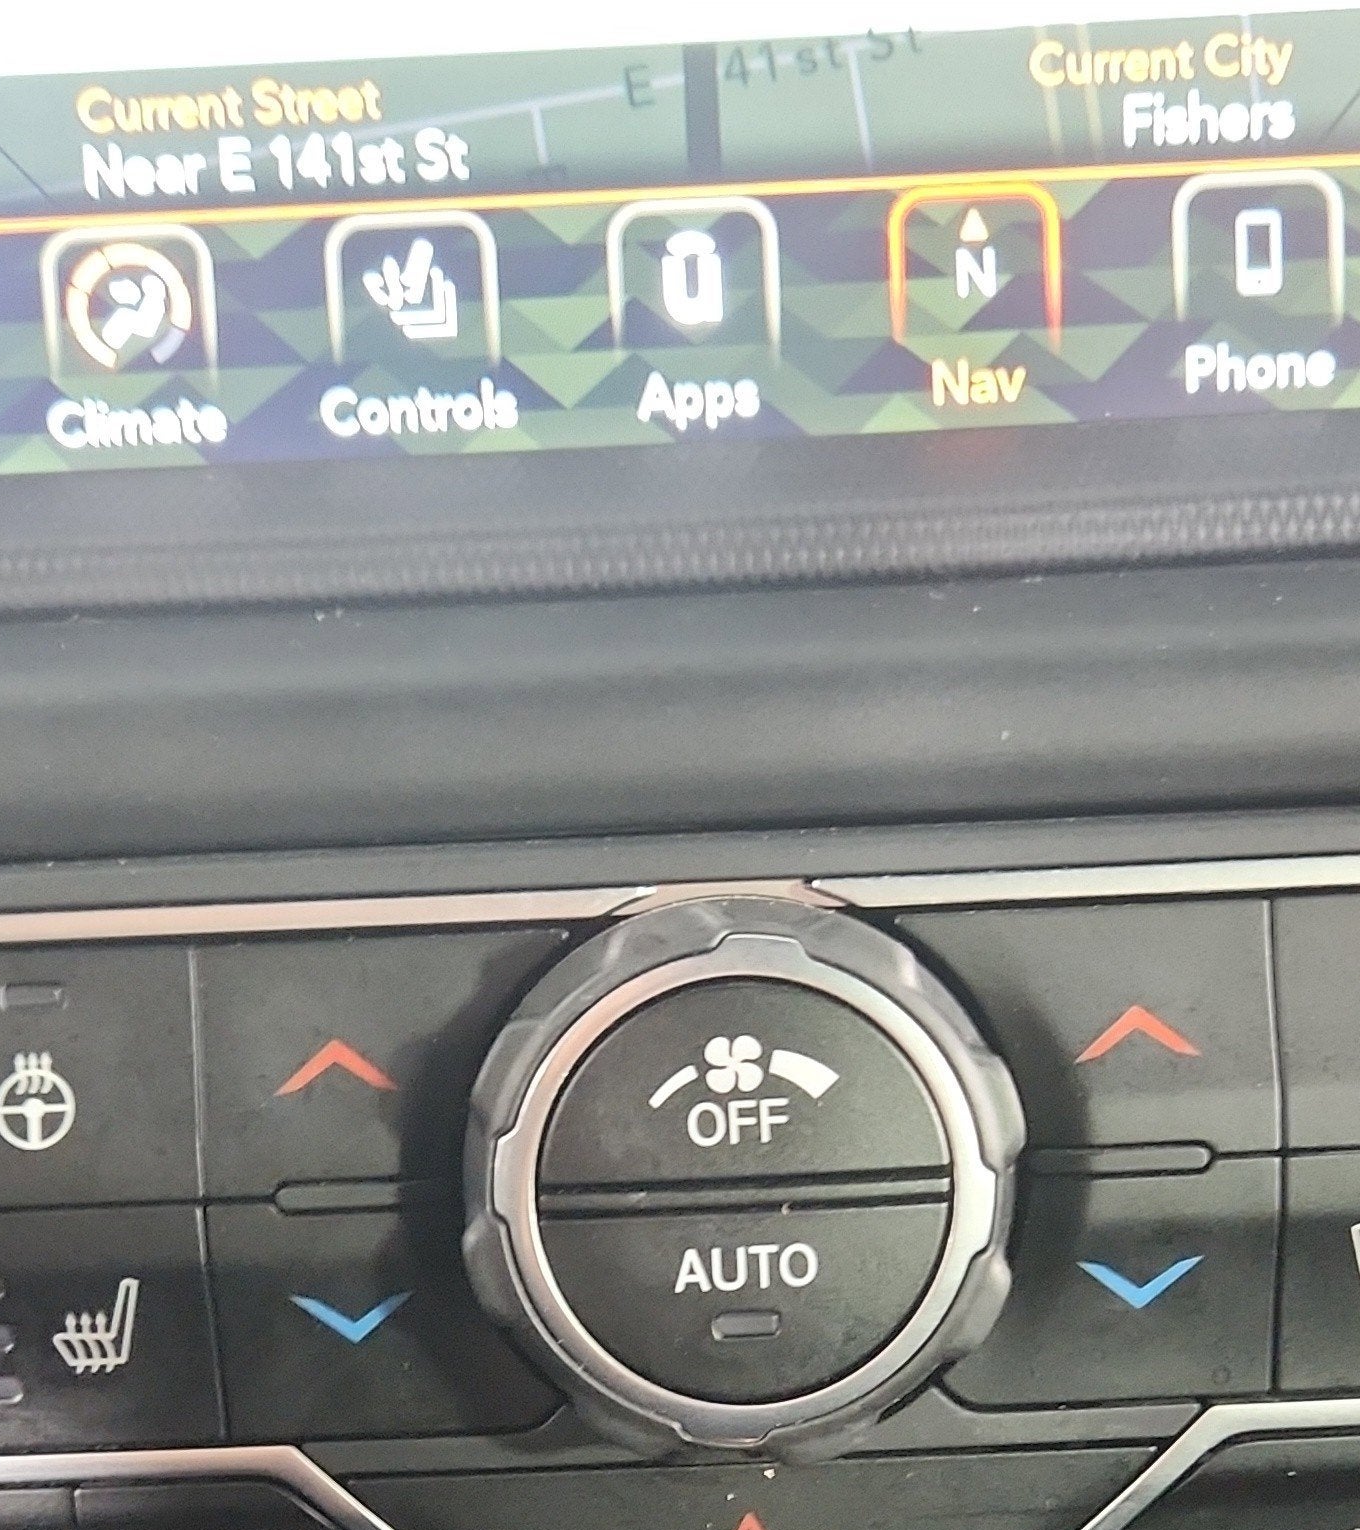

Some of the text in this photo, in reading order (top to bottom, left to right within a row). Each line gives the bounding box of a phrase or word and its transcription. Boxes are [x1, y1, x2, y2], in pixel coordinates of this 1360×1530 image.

[1029, 33, 1292, 87] Current City
[77, 76, 382, 135] Current Street
[1122, 89, 1295, 148] Fishers
[82, 127, 469, 199] Near E 141st St
[931, 358, 1028, 407] Nav
[1185, 342, 1336, 394] Phone
[47, 398, 227, 448] Climate
[320, 377, 518, 436] Controls
[637, 371, 759, 429] Apps
[687, 1097, 790, 1147] OFF
[674, 1242, 818, 1293] AUTO
